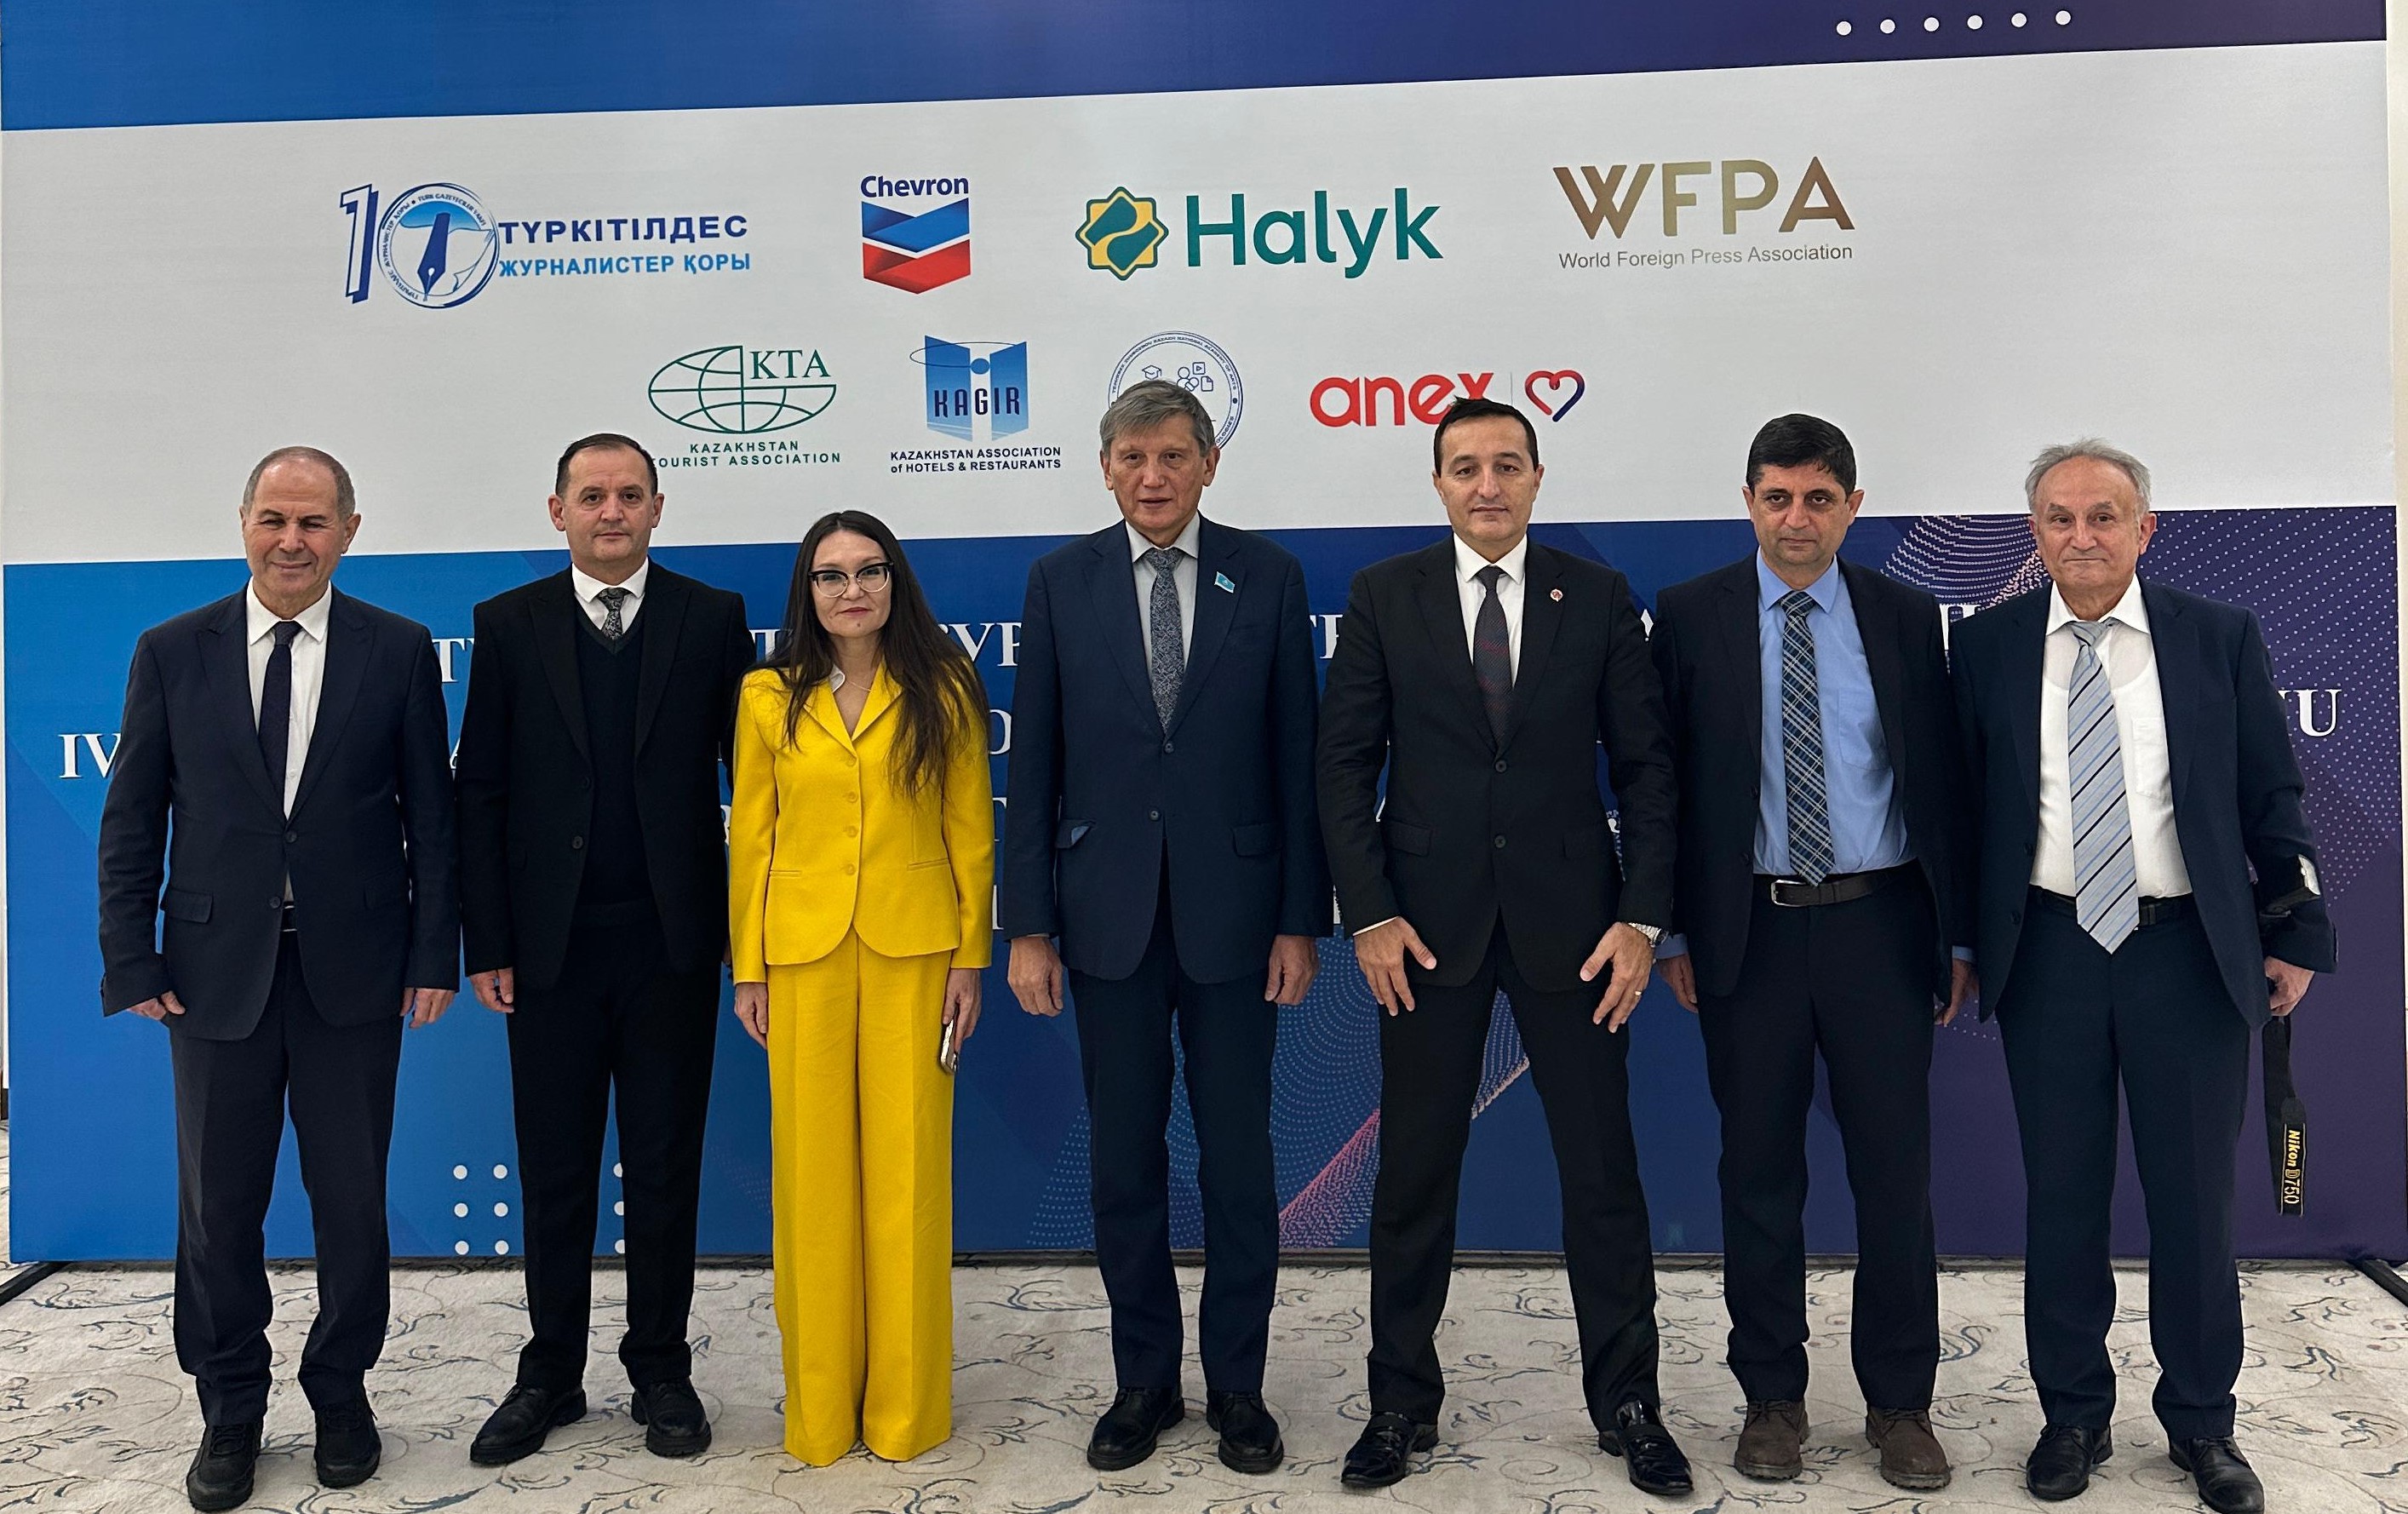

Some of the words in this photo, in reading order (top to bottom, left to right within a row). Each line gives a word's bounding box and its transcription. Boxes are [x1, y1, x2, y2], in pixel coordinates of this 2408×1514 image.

[860, 175, 969, 198] Chevron
[1553, 156, 1855, 239] WFPA
[1186, 187, 1443, 278] Halyk
[499, 255, 674, 277] ЖУРНАЛИСТЕР
[684, 253, 750, 274] ҚОРЫ
[1559, 251, 1610, 269] World
[1618, 249, 1685, 269] Foreign
[1691, 248, 1742, 264] Press
[1747, 244, 1853, 263] Association
[749, 349, 831, 380] KTA
[934, 387, 1020, 418] KAGIR
[690, 440, 799, 454] KAZAKHSTAN
[891, 450, 973, 461] KAZAKHSTAN
[977, 447, 1061, 459] ASSOCIATION
[729, 453, 841, 467] ASSOCIATION
[891, 464, 903, 473] of
[906, 462, 955, 473] HOTELS
[959, 462, 966, 472] &
[971, 459, 1061, 471] RESTAURANTS
[2287, 1130, 2301, 1167] Nikon
[2284, 1169, 2301, 1204] D750
